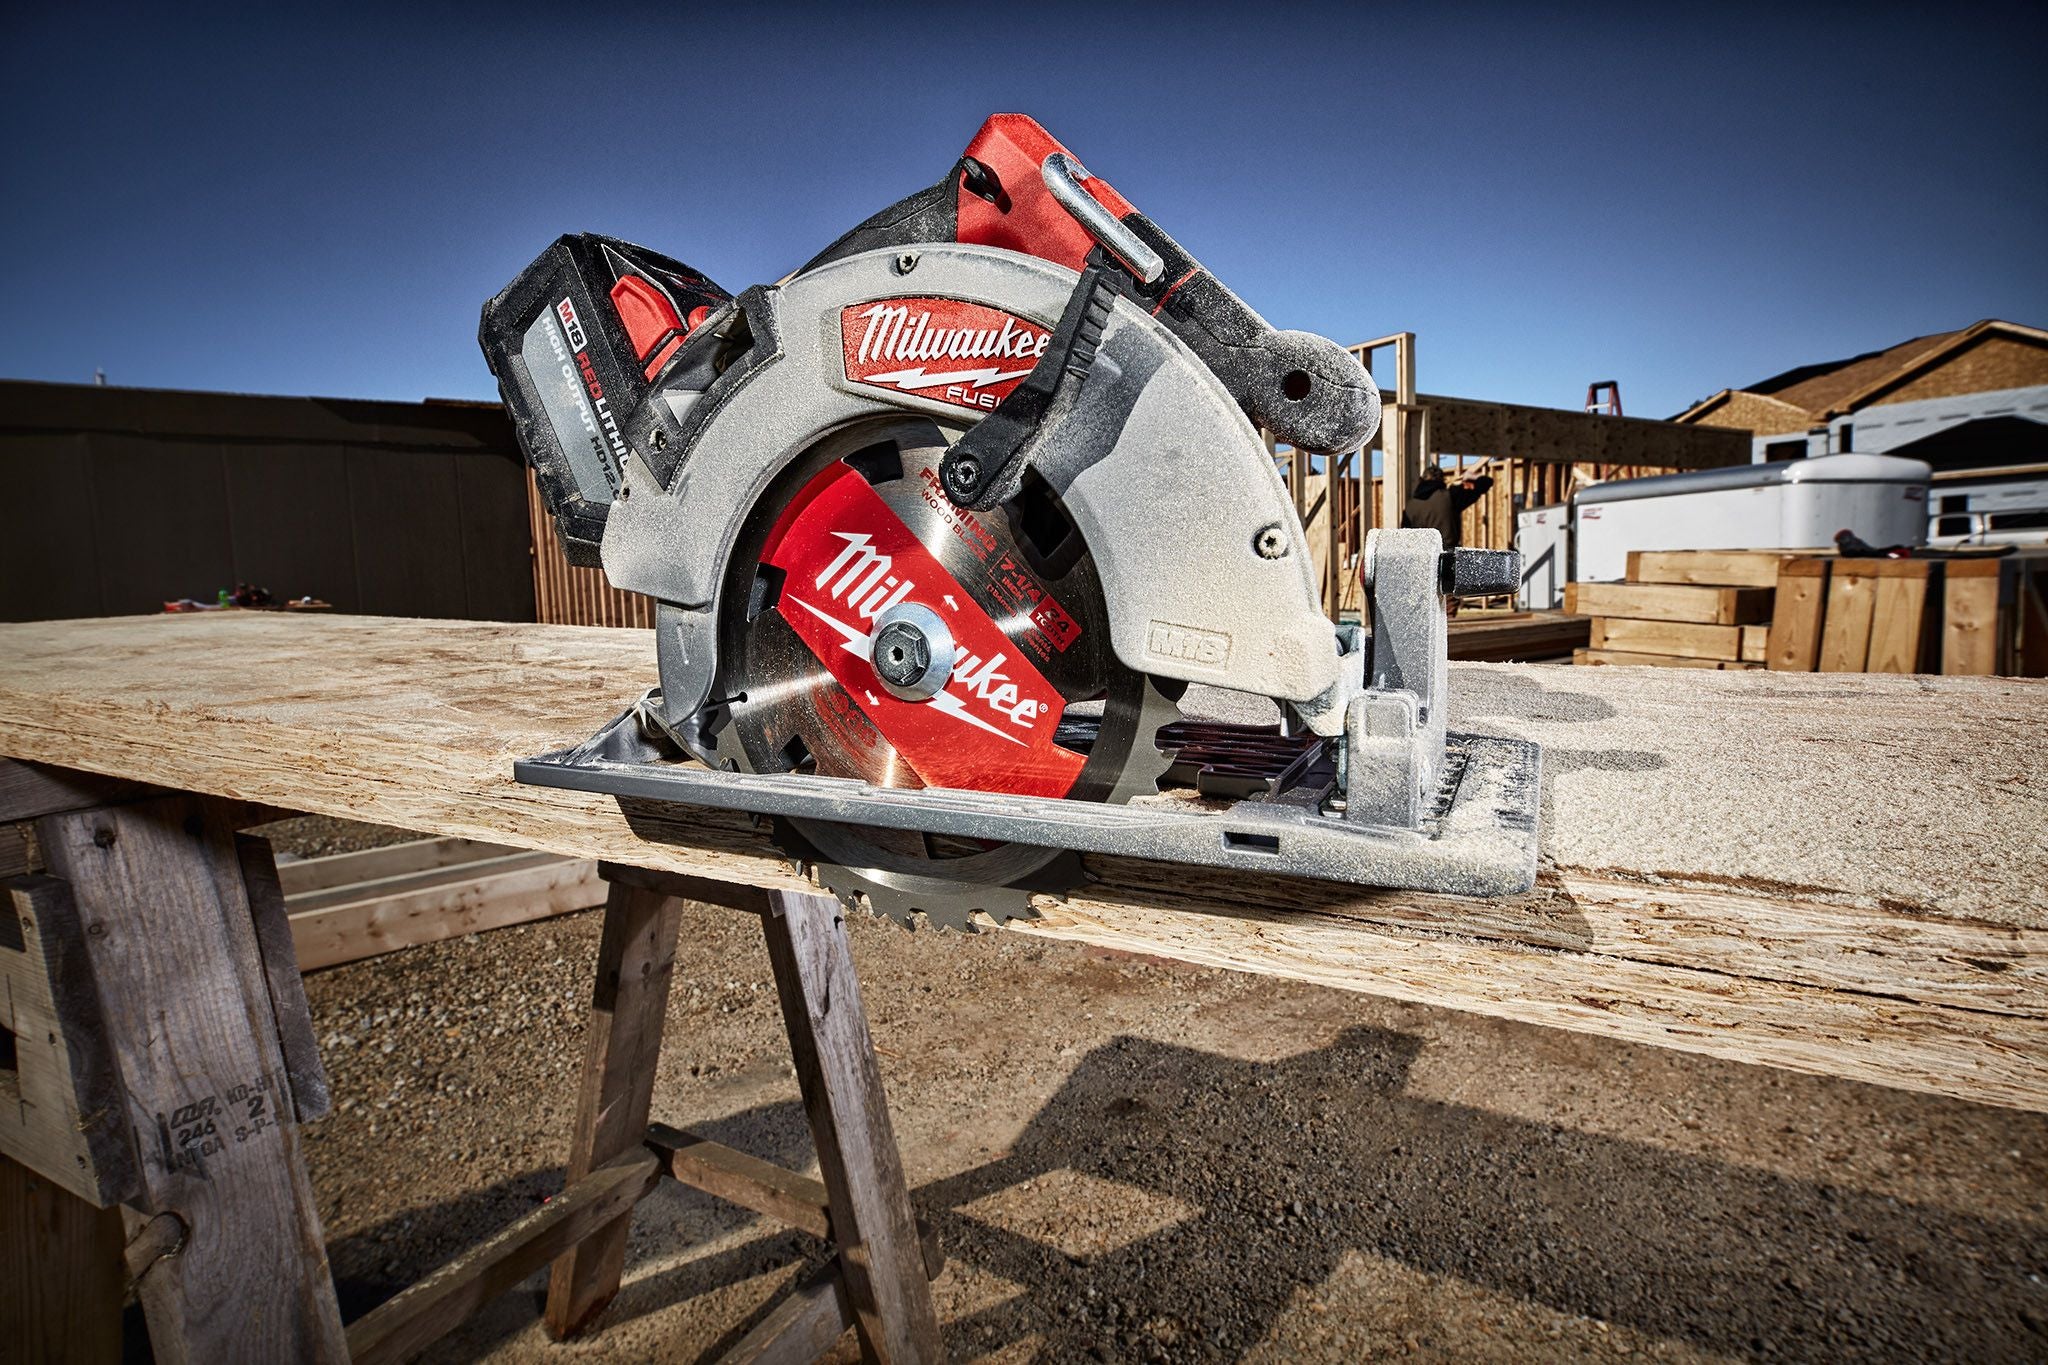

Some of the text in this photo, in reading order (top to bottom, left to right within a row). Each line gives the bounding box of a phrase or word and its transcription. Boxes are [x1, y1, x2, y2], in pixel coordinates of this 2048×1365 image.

[542, 316, 564, 362] HIGH
[562, 365, 596, 433] OUTPUT
[558, 301, 629, 469] M18 REDLITHIU
[946, 386, 1001, 409] FUE
[921, 489, 988, 562] WOOD BLADE
[1000, 557, 1042, 602] 7-1/4
[1002, 576, 1025, 600] INCH
[1044, 607, 1071, 633] 24
[247, 1095, 266, 1119] 2
[178, 1118, 217, 1146] 246
